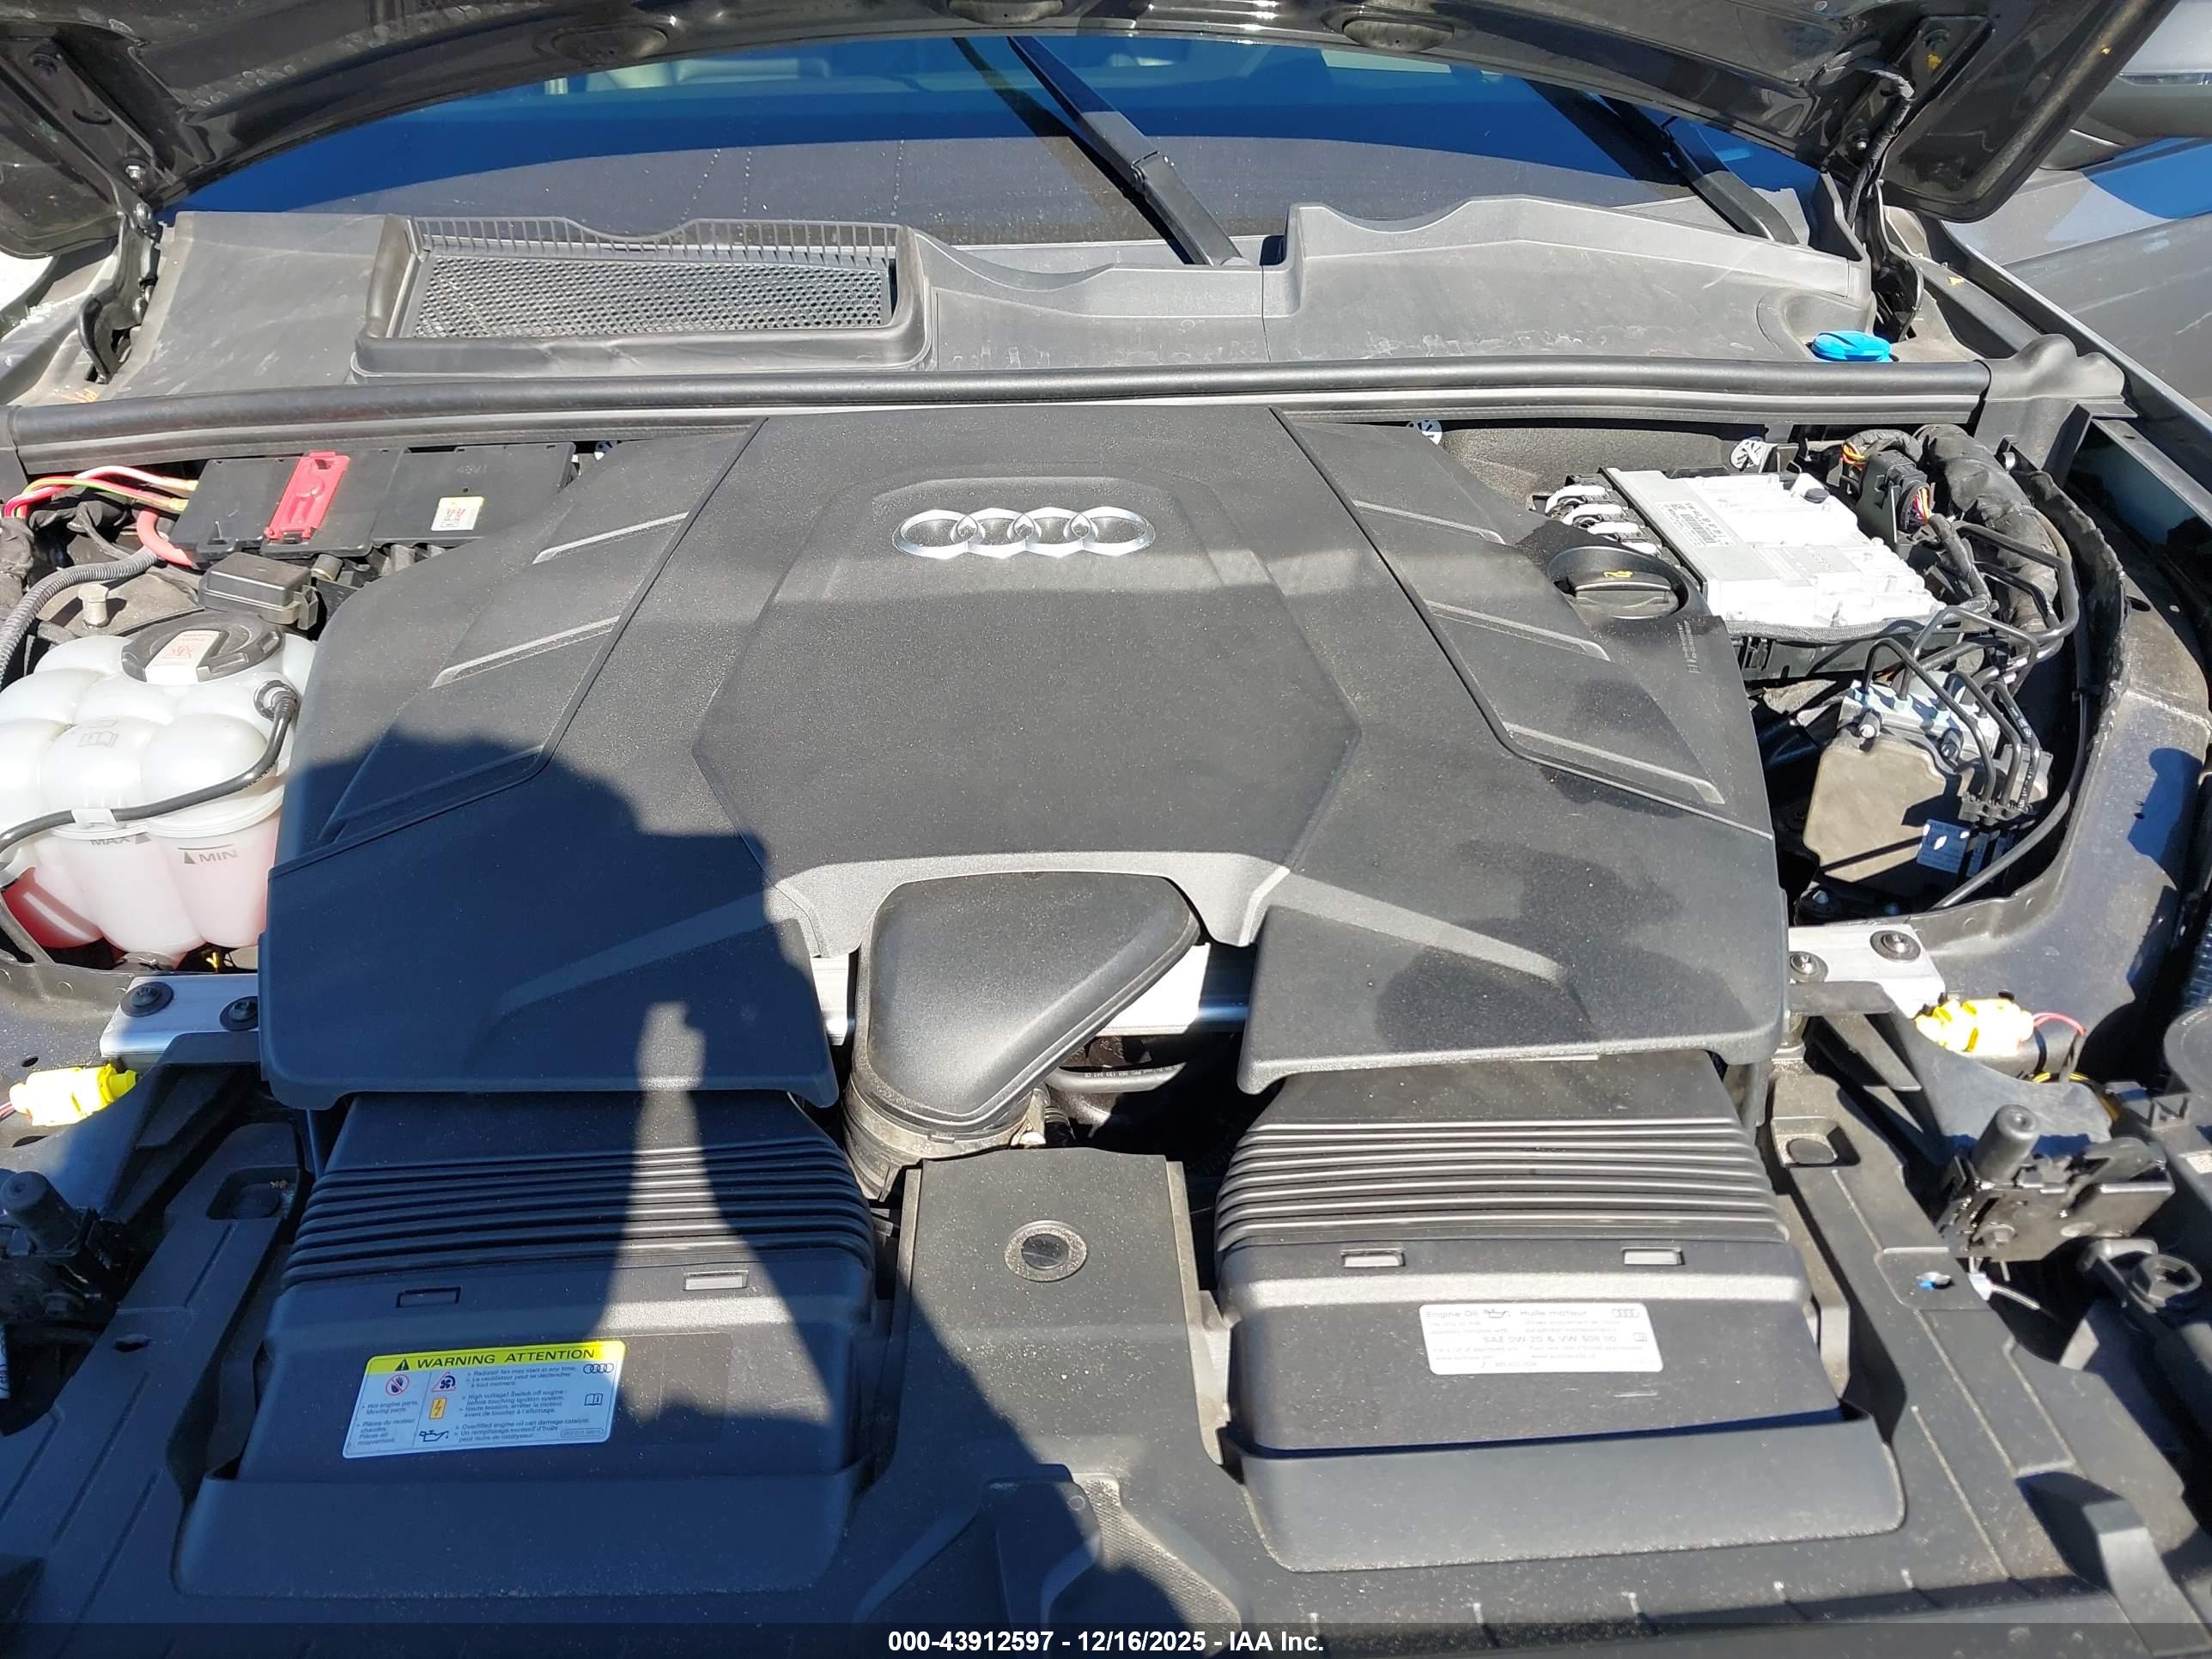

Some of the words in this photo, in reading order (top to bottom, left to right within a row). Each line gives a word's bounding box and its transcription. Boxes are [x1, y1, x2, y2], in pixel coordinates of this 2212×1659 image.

[198, 849, 239, 864] MIN
[416, 1354, 495, 1368] WARNING
[504, 1348, 594, 1363] ATTENTION
